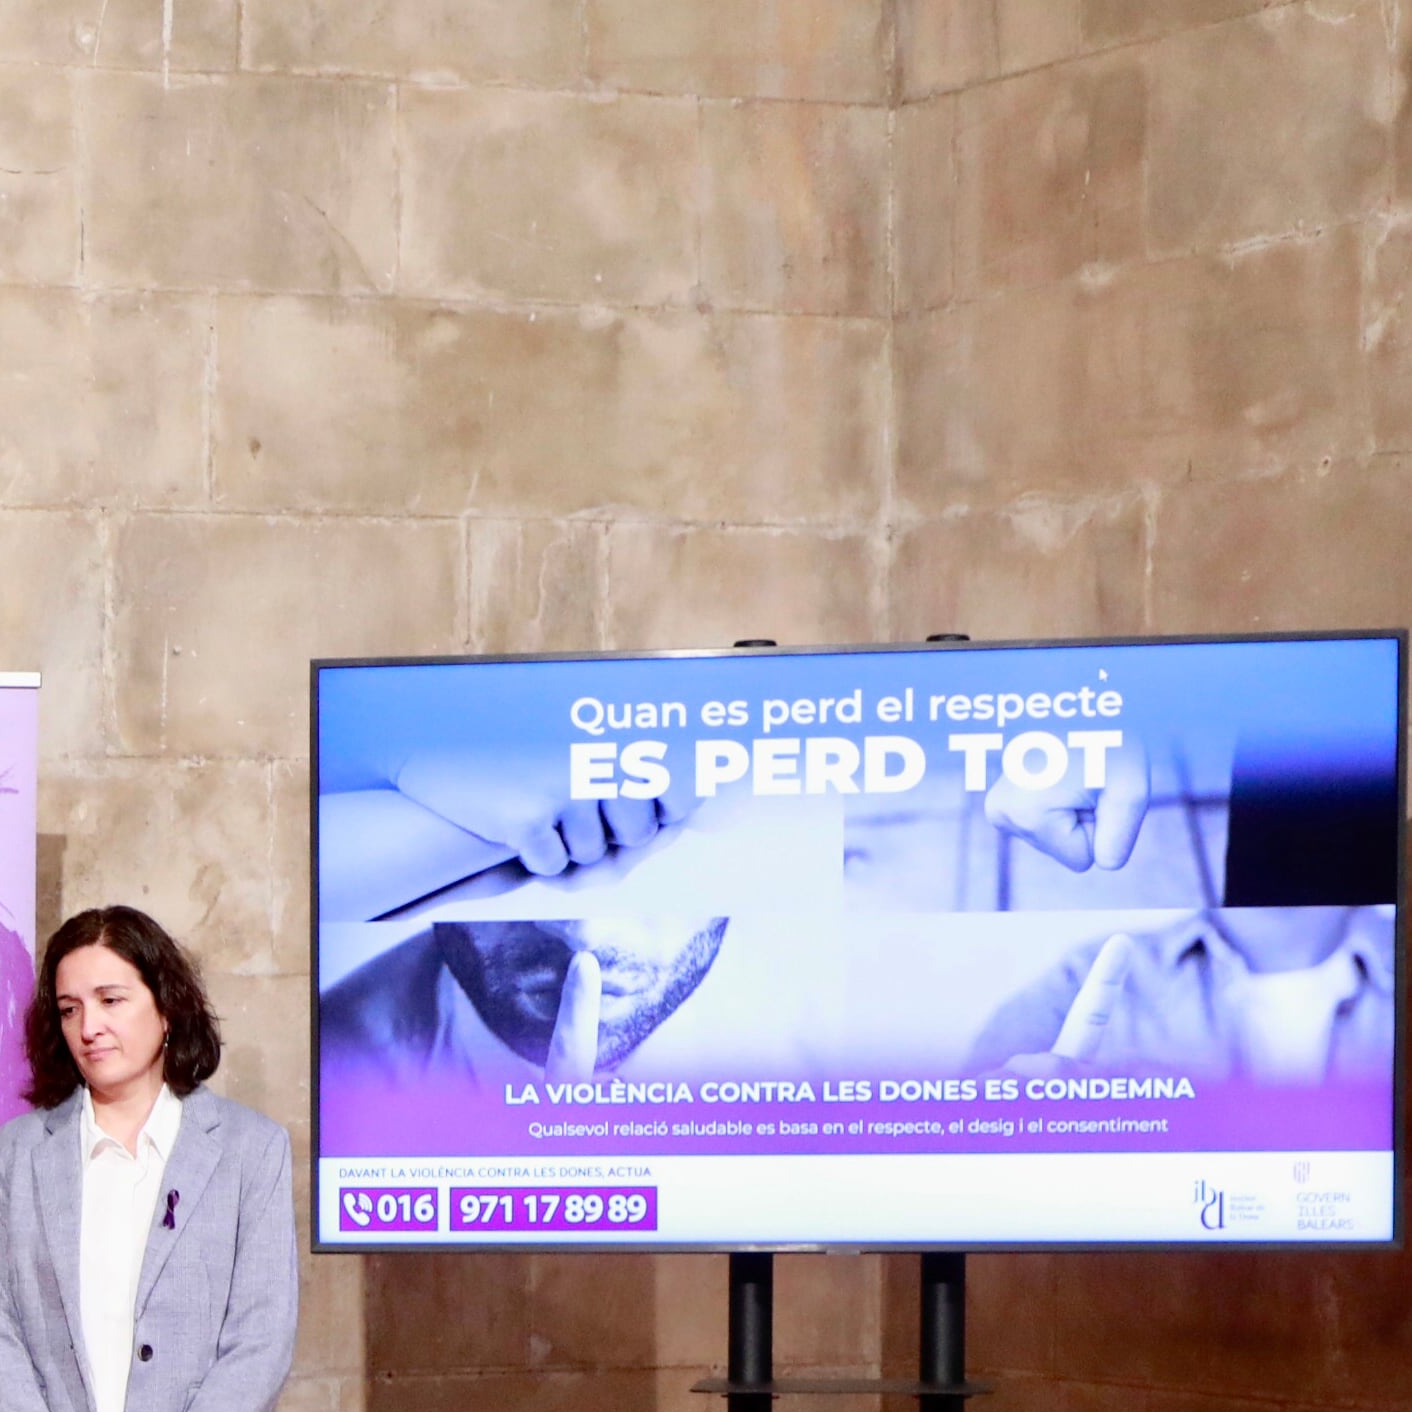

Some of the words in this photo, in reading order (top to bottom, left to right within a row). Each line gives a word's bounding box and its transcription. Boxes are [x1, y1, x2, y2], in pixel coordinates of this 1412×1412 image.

[570, 697, 687, 735] Quan
[700, 699, 749, 727] es
[763, 689, 863, 732] perd
[876, 688, 914, 722] el
[929, 686, 1123, 727] respecte
[570, 741, 670, 800] ES
[695, 735, 926, 797] PERD
[948, 730, 1123, 792] TOT
[505, 1084, 540, 1104] LA
[545, 1078, 694, 1104] VIOLÈNCIA
[700, 1081, 816, 1103] CONTRA
[823, 1080, 872, 1102] LES
[879, 1080, 977, 1101] DONES
[984, 1079, 1019, 1100] ES
[1025, 1078, 1195, 1100] CONDEMNA
[528, 1121, 609, 1138] Qualsevol
[613, 1120, 668, 1136] relació
[672, 1120, 752, 1137] saludable
[756, 1124, 775, 1135] es
[780, 1120, 818, 1135] basa
[823, 1122, 844, 1134] en
[848, 1119, 863, 1134] el
[867, 1119, 945, 1137] respecte,
[949, 1118, 964, 1133] el
[968, 1118, 1014, 1137] desig
[1018, 1118, 1025, 1132] i
[1028, 1118, 1043, 1133] el
[1046, 1117, 1168, 1133] consentiment
[339, 1167, 387, 1178] DAVANT
[391, 1167, 406, 1178] LA
[478, 1167, 530, 1178] CONTRA
[534, 1167, 556, 1177] LES
[608, 1166, 651, 1177] ACTUA
[379, 1194, 435, 1222] 016
[459, 1195, 514, 1223] 971
[523, 1194, 561, 1223] 17
